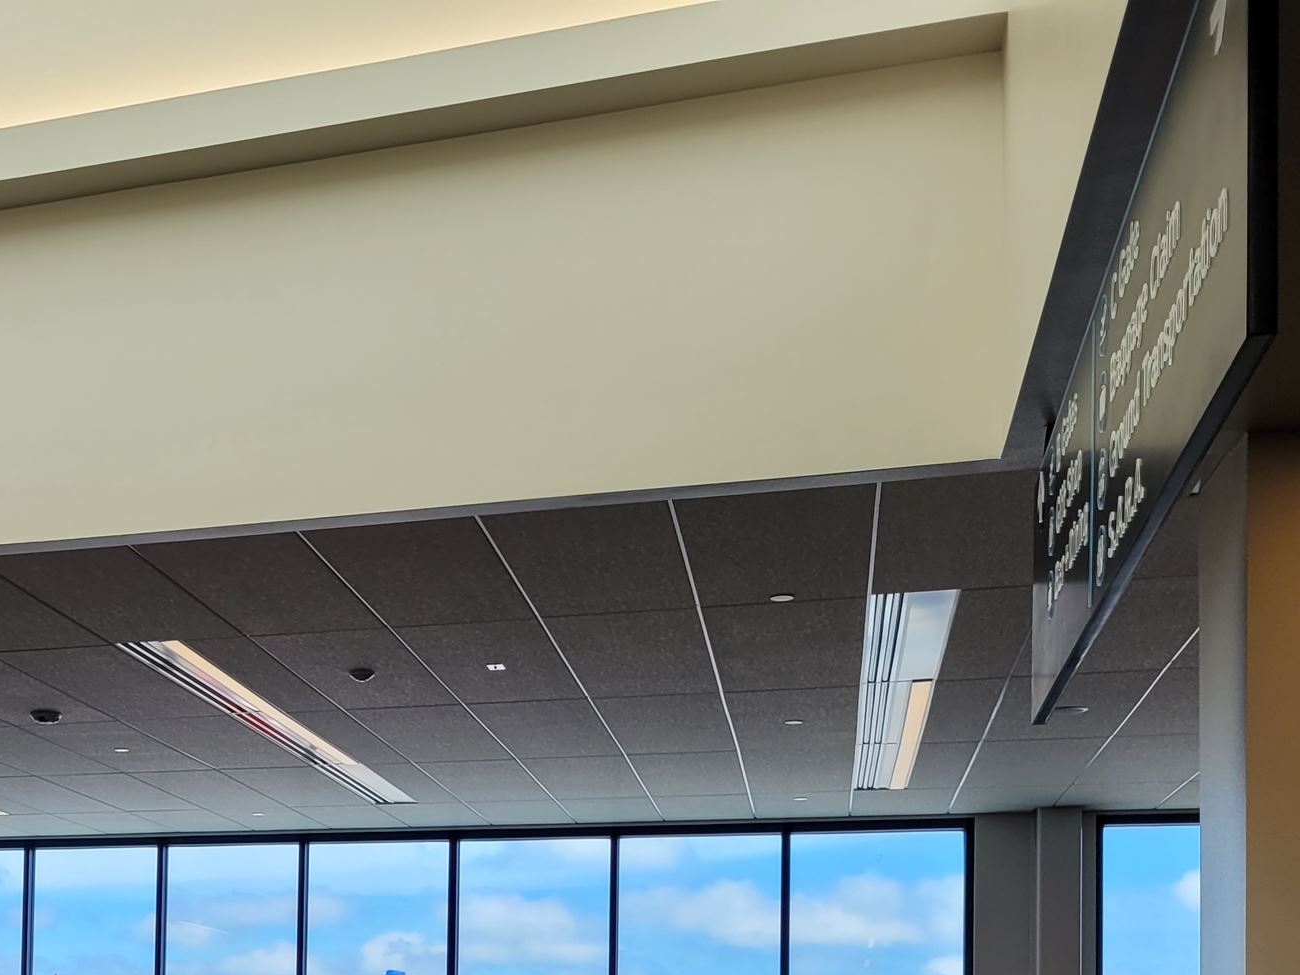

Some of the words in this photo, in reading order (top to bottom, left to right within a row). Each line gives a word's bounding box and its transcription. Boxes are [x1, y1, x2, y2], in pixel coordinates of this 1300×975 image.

[1109, 282, 1148, 402] Baggage
[1150, 200, 1181, 300] Claim
[1109, 370, 1141, 478] Ground
[1142, 187, 1228, 407] Transportation
